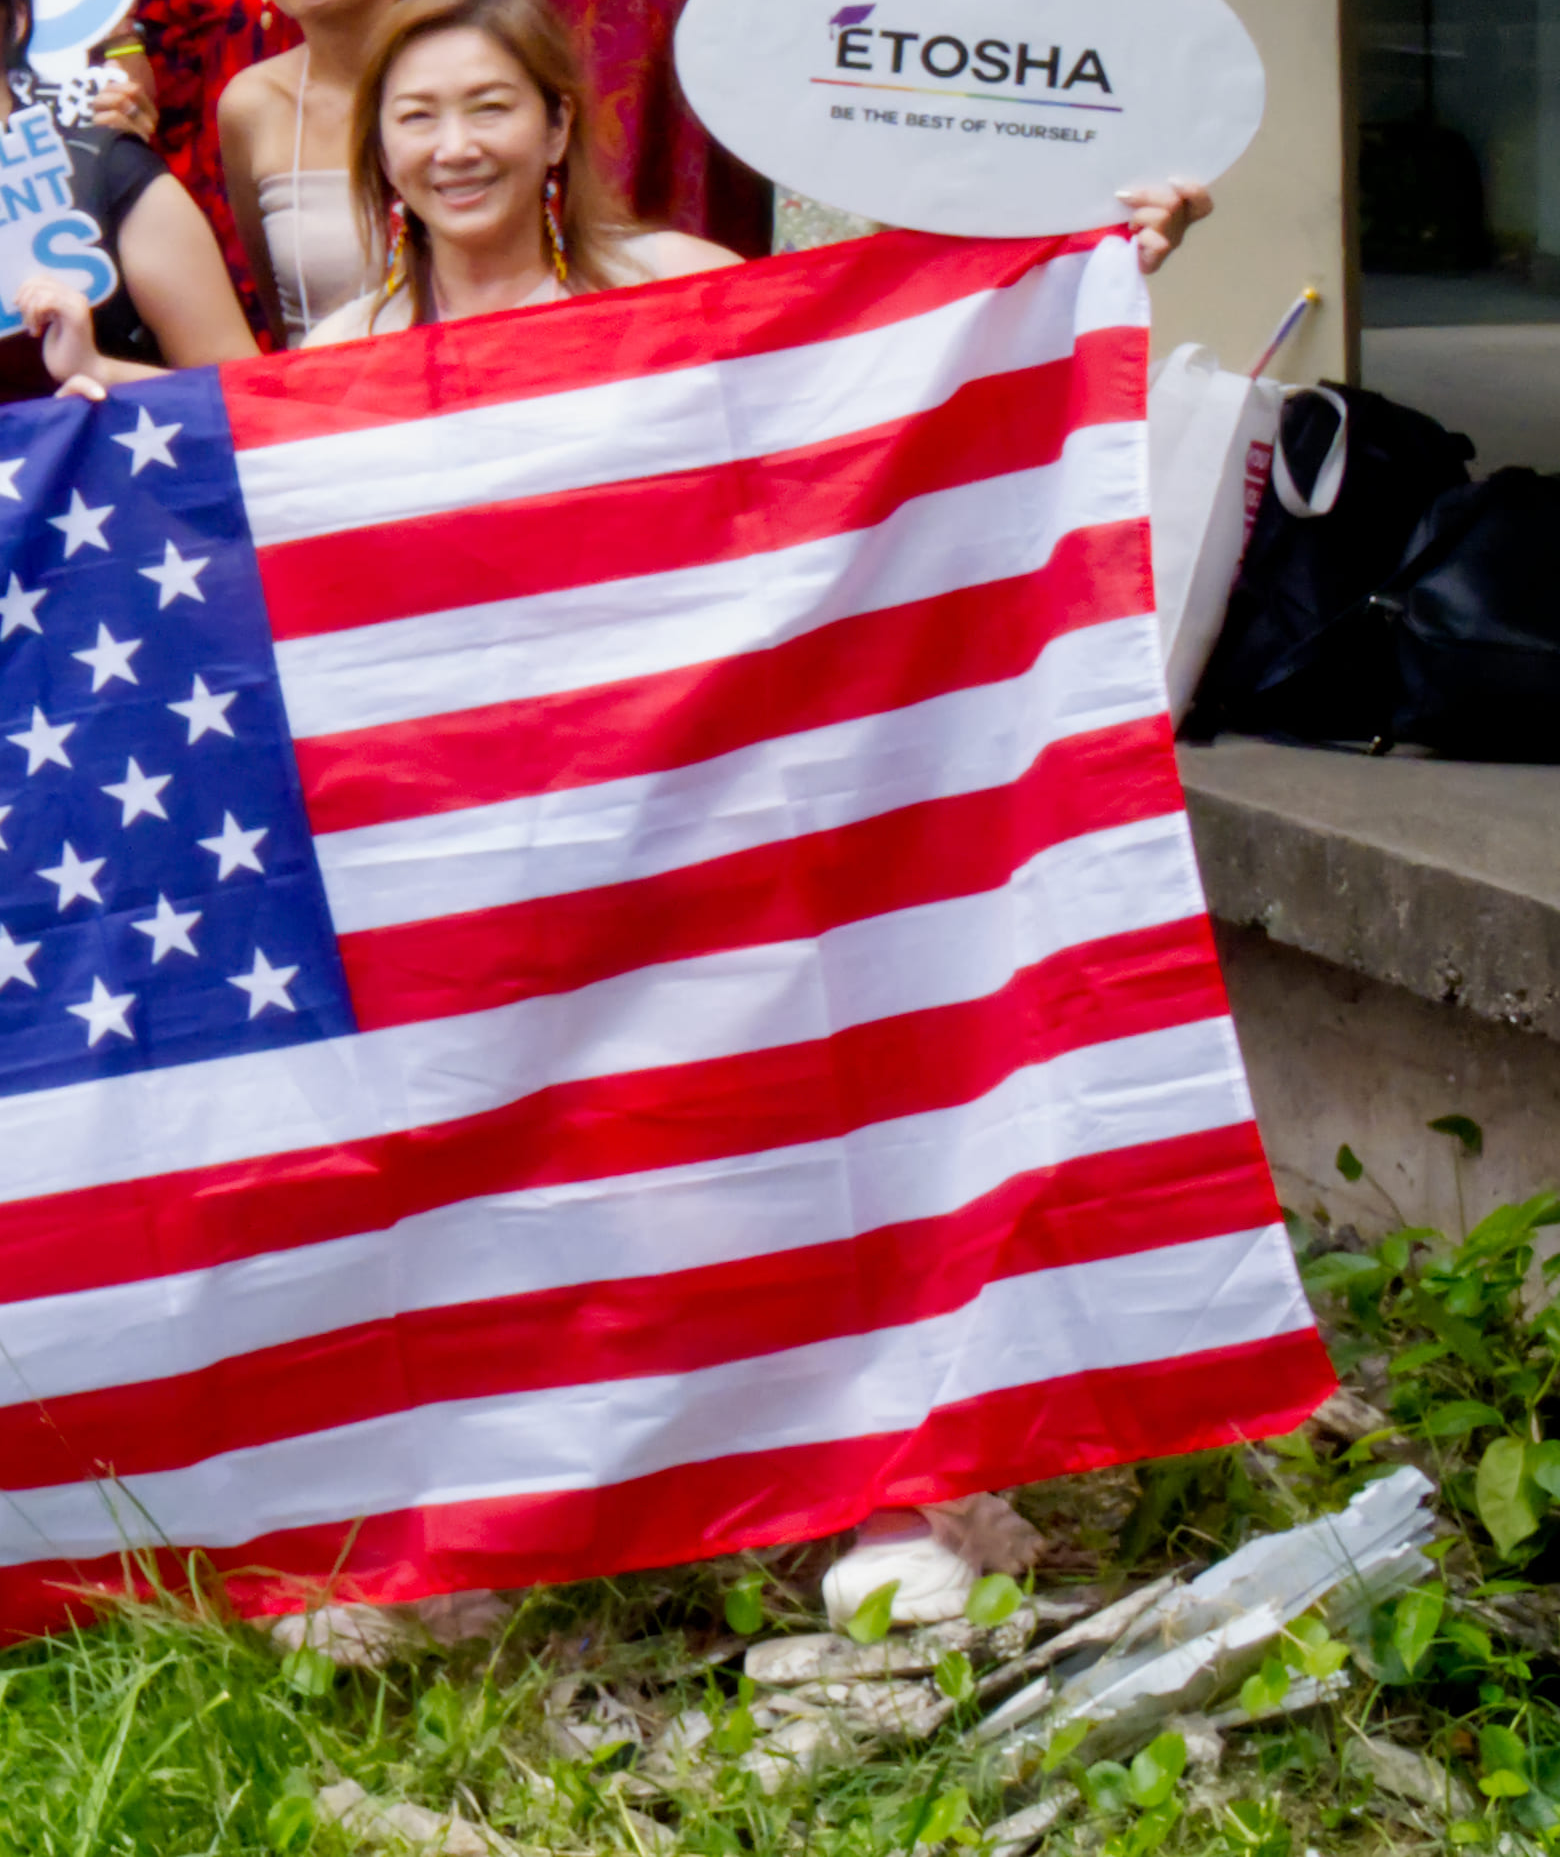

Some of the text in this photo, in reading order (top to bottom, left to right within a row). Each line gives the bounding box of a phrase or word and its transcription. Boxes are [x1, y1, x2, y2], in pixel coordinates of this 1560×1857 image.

[835, 28, 1114, 94] ETOSHA
[830, 105, 1098, 143] BE THE BEST OF YOURSELF
